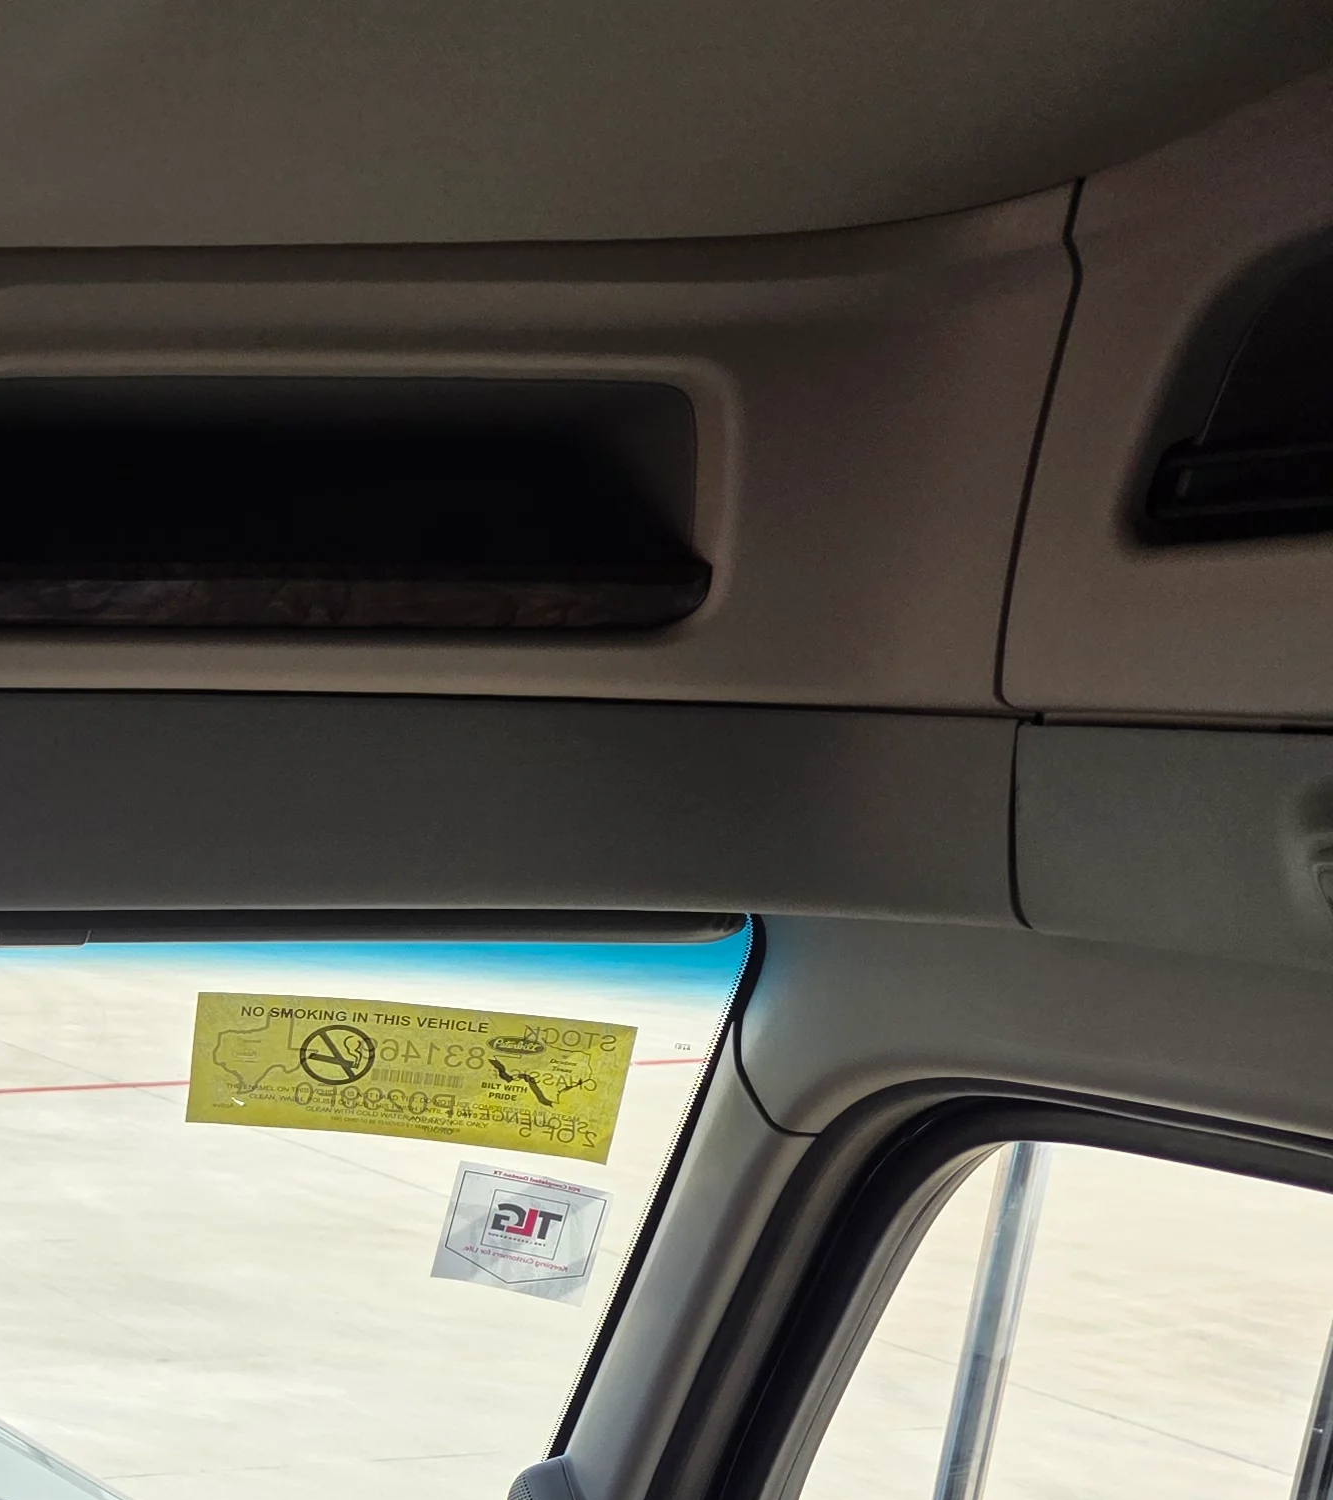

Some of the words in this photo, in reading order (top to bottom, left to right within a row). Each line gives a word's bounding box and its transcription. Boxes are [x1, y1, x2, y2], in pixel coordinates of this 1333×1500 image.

[241, 1005, 264, 1017] NO
[269, 1007, 347, 1022] SMOKING
[352, 1012, 368, 1023] IN
[373, 1013, 411, 1027] THIS
[416, 1016, 489, 1034] VEHICLE
[492, 1038, 541, 1052] Peterbilt
[481, 1081, 501, 1090] BILT
[503, 1083, 528, 1093] WITH
[488, 1091, 517, 1101] PRIDE
[305, 1105, 332, 1113] CLEAN
[334, 1107, 354, 1115] WITH
[356, 1109, 379, 1117] COLD
[380, 1111, 409, 1120] WATER
